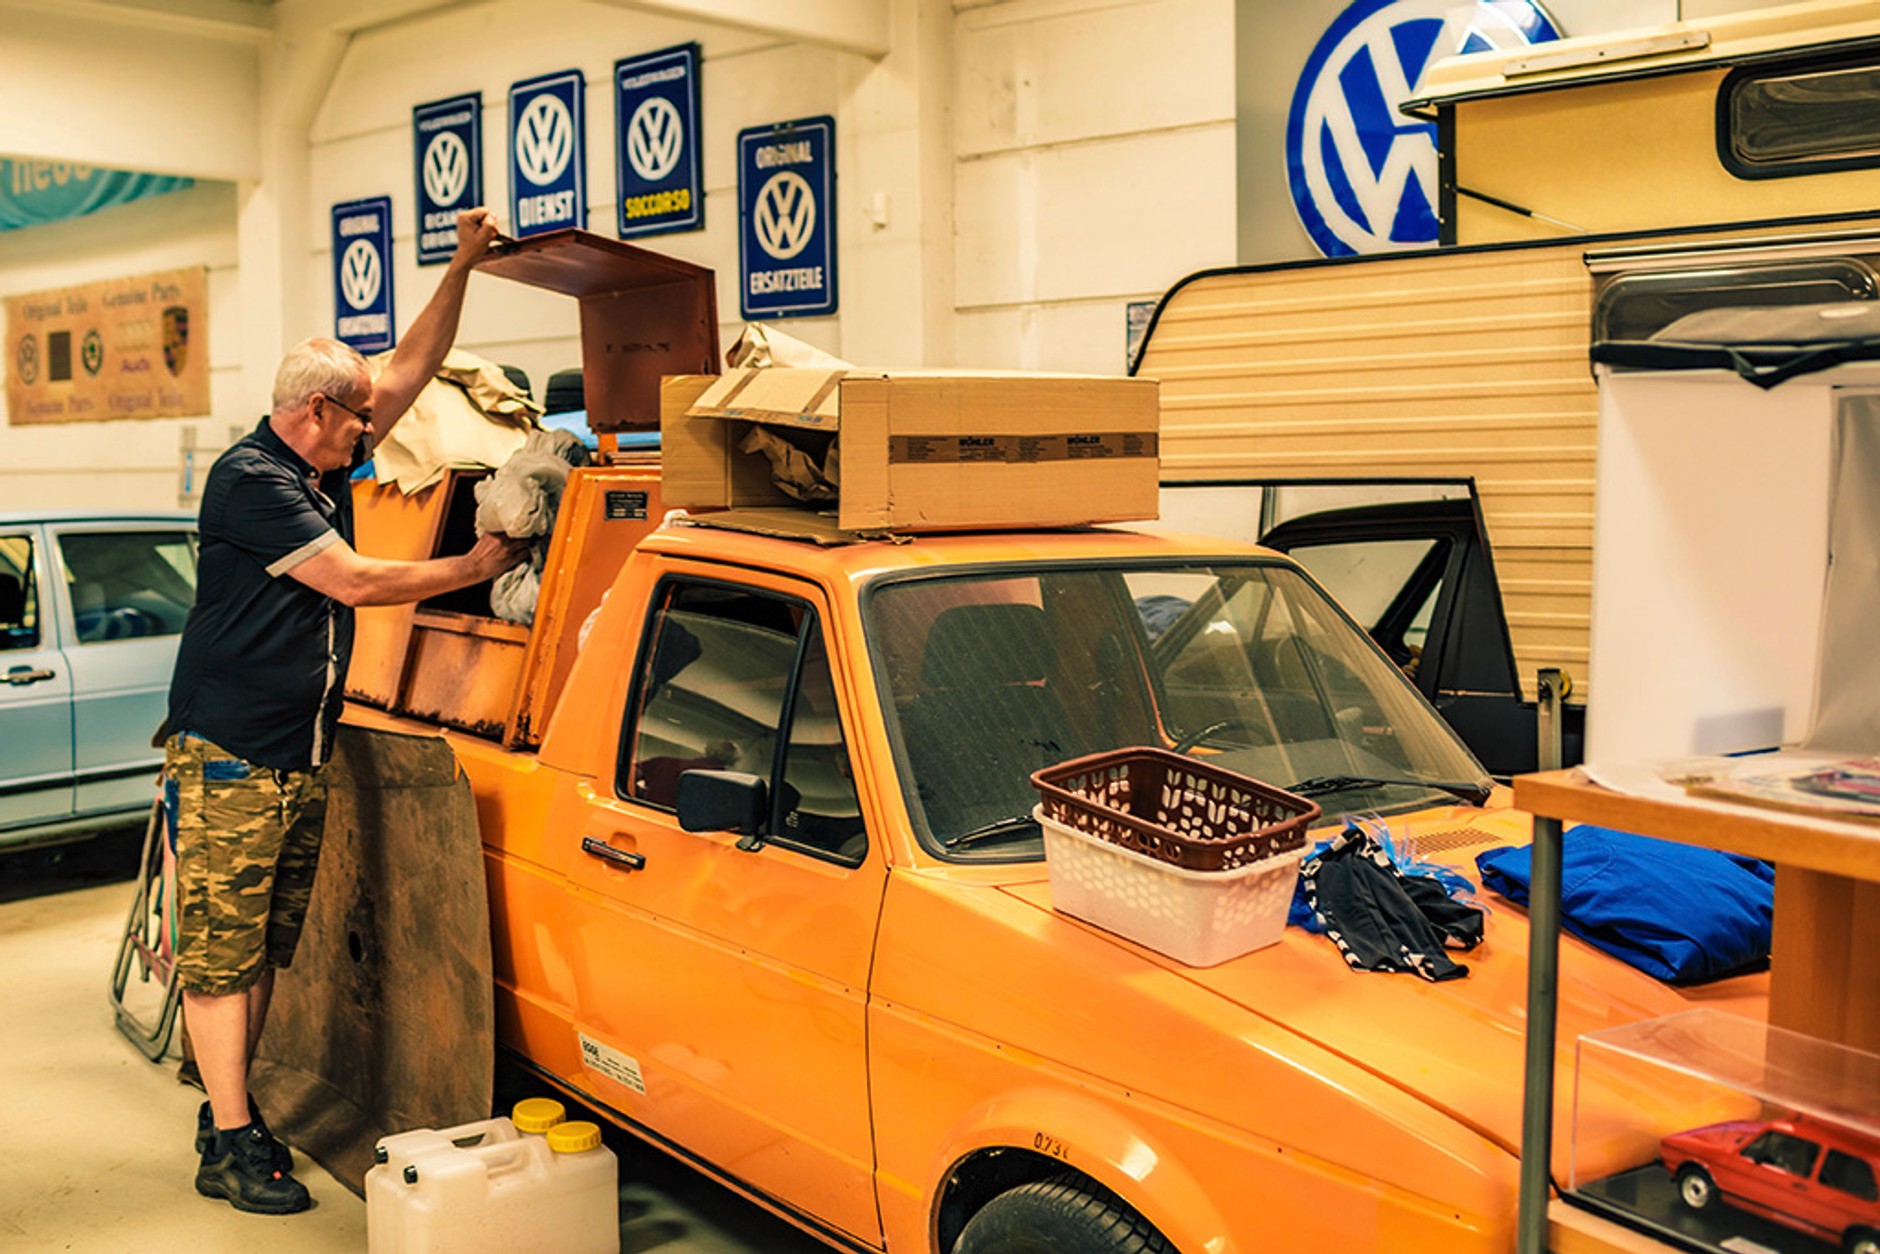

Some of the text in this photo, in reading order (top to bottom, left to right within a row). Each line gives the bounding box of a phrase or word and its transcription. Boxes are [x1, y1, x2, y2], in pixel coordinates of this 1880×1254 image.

[423, 131, 469, 207] VW
[516, 93, 573, 186] VW
[627, 97, 684, 181] VW
[755, 140, 814, 169] ORIGINAL
[519, 189, 575, 227] DIENST
[625, 188, 691, 219] SOCCORSO
[754, 170, 816, 260] VW
[341, 238, 382, 310] VW
[750, 266, 823, 295] ERSATZTEILE
